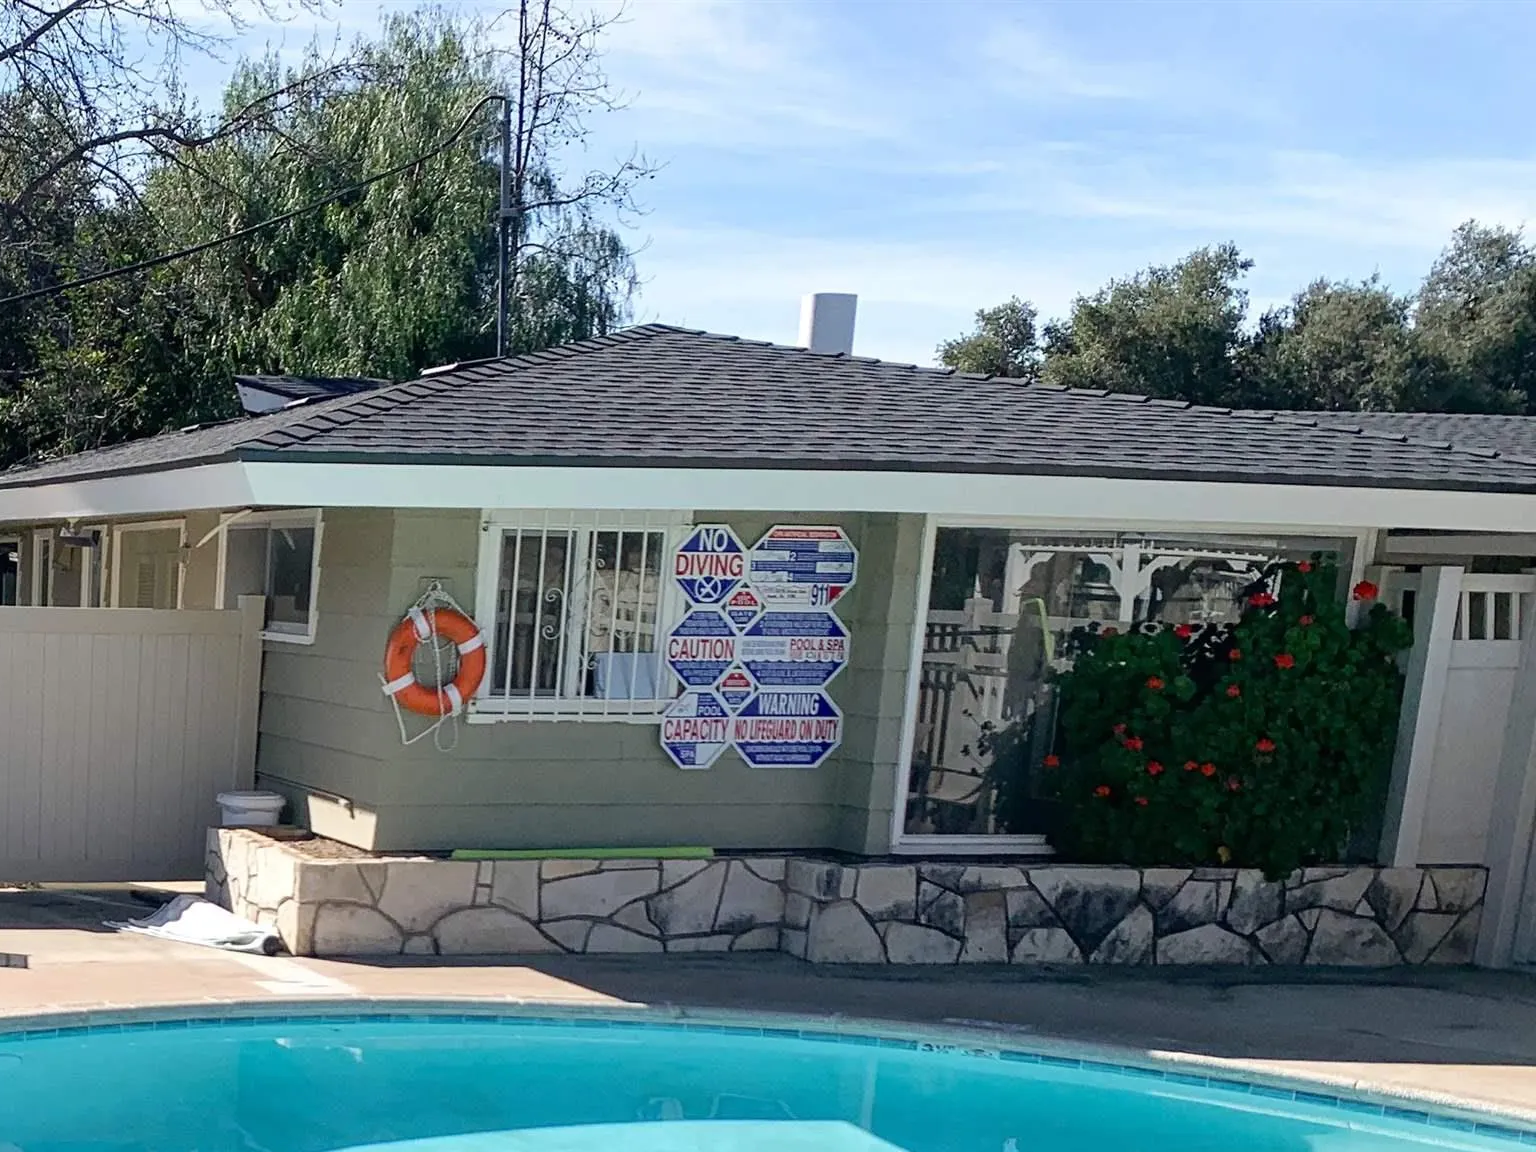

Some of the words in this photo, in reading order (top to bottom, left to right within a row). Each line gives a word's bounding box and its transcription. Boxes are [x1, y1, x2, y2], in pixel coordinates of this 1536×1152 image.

[699, 529, 728, 552] NO
[675, 554, 744, 576] DIVING
[811, 584, 829, 606] 911
[668, 639, 735, 659] CAUTION
[791, 639, 816, 650] POOL
[818, 639, 824, 650] &
[827, 639, 845, 651] SPA
[697, 706, 723, 716] POOL
[758, 693, 820, 716] WARNING
[664, 719, 729, 741] CAPACITY
[735, 719, 748, 740] NO
[750, 719, 797, 741] LIFEGUARD
[799, 719, 813, 740] ON
[815, 719, 839, 740] DUTY
